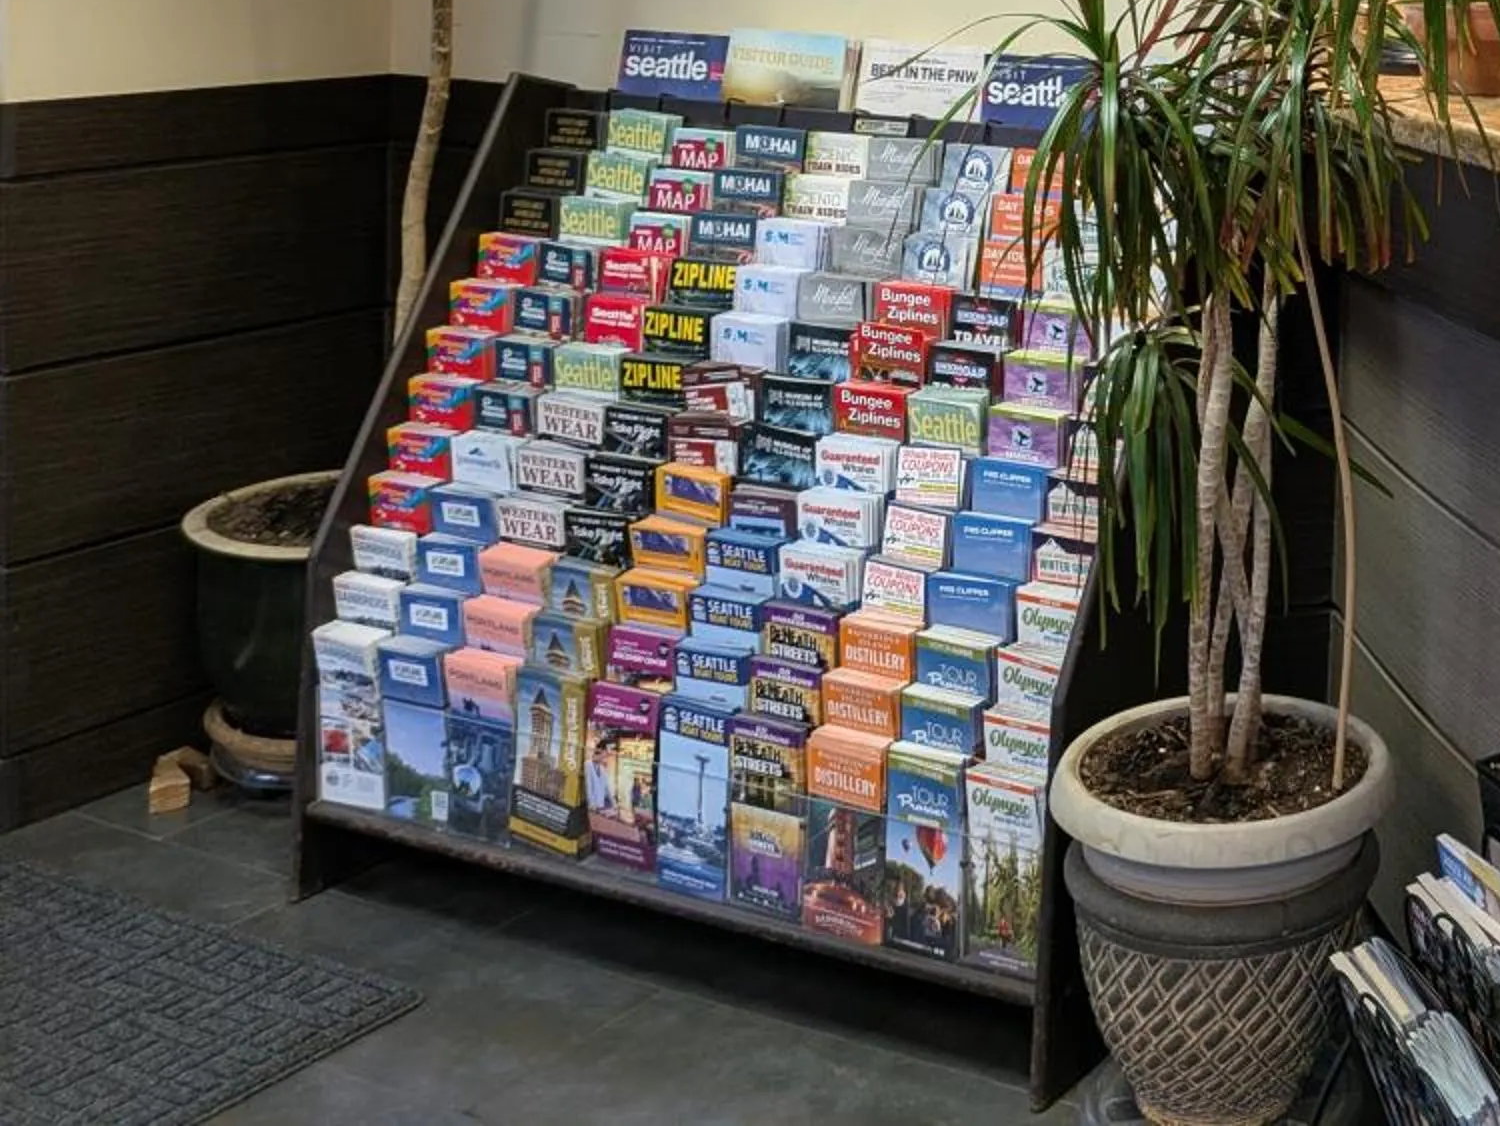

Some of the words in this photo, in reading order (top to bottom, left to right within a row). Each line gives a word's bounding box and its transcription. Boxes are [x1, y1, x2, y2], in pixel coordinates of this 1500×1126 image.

[625, 51, 708, 80] seattle
[905, 65, 918, 78] IN
[919, 67, 945, 81] THE
[947, 69, 978, 83] PNW
[987, 75, 1068, 107] seattl
[610, 118, 663, 153] Seattle
[678, 150, 719, 168] MAP
[588, 155, 644, 195] Seattle
[655, 190, 695, 209] MAP
[561, 203, 616, 237] Seattle
[636, 234, 676, 252] MAP
[673, 262, 736, 290] ZIPLINE
[881, 288, 931, 307] Bungee
[887, 305, 938, 325] Ziplines
[645, 311, 704, 343] ZIPLINE
[861, 325, 912, 345] Bungee
[868, 343, 921, 363] Ziplines
[555, 354, 613, 390] Seattle
[623, 362, 681, 390] ZIPLINE
[841, 389, 893, 410] Bungee
[543, 403, 599, 423] WESTERN
[848, 408, 901, 428] Ziplines
[544, 415, 598, 441] WEAR
[911, 405, 977, 443] Seattle
[520, 453, 577, 472] WESTERN
[820, 449, 881, 465] Guaranteed
[901, 460, 955, 474] COUPONS
[522, 465, 576, 490] WEAR
[499, 505, 557, 524] WESTERN
[802, 503, 861, 520] Guaranteed
[503, 521, 556, 542] WEAR
[890, 521, 941, 538] COUPONS
[722, 543, 765, 561] SEATTLE
[784, 558, 844, 578] Guaranteed
[867, 575, 919, 594] COUPONS
[707, 600, 752, 618] SEATTLE
[1022, 607, 1075, 634] Olympi
[769, 624, 817, 650] BENEATH
[692, 654, 737, 671] SEATTLE
[771, 642, 818, 665] STREETS
[845, 646, 905, 672] DISTILLERY
[940, 664, 976, 685] TOUR
[755, 679, 803, 705] BENEATH
[757, 698, 803, 720] STREETS
[827, 701, 889, 727] DISTILLERY
[679, 711, 724, 733] SEATTLE
[926, 722, 963, 743] TOUR
[733, 736, 781, 763] BENEATH
[990, 729, 1046, 756] Olympic
[734, 754, 782, 776] STREETS
[815, 766, 877, 796] DISTILLERY
[912, 785, 949, 806] TOUR
[972, 787, 1029, 816] Olympic
